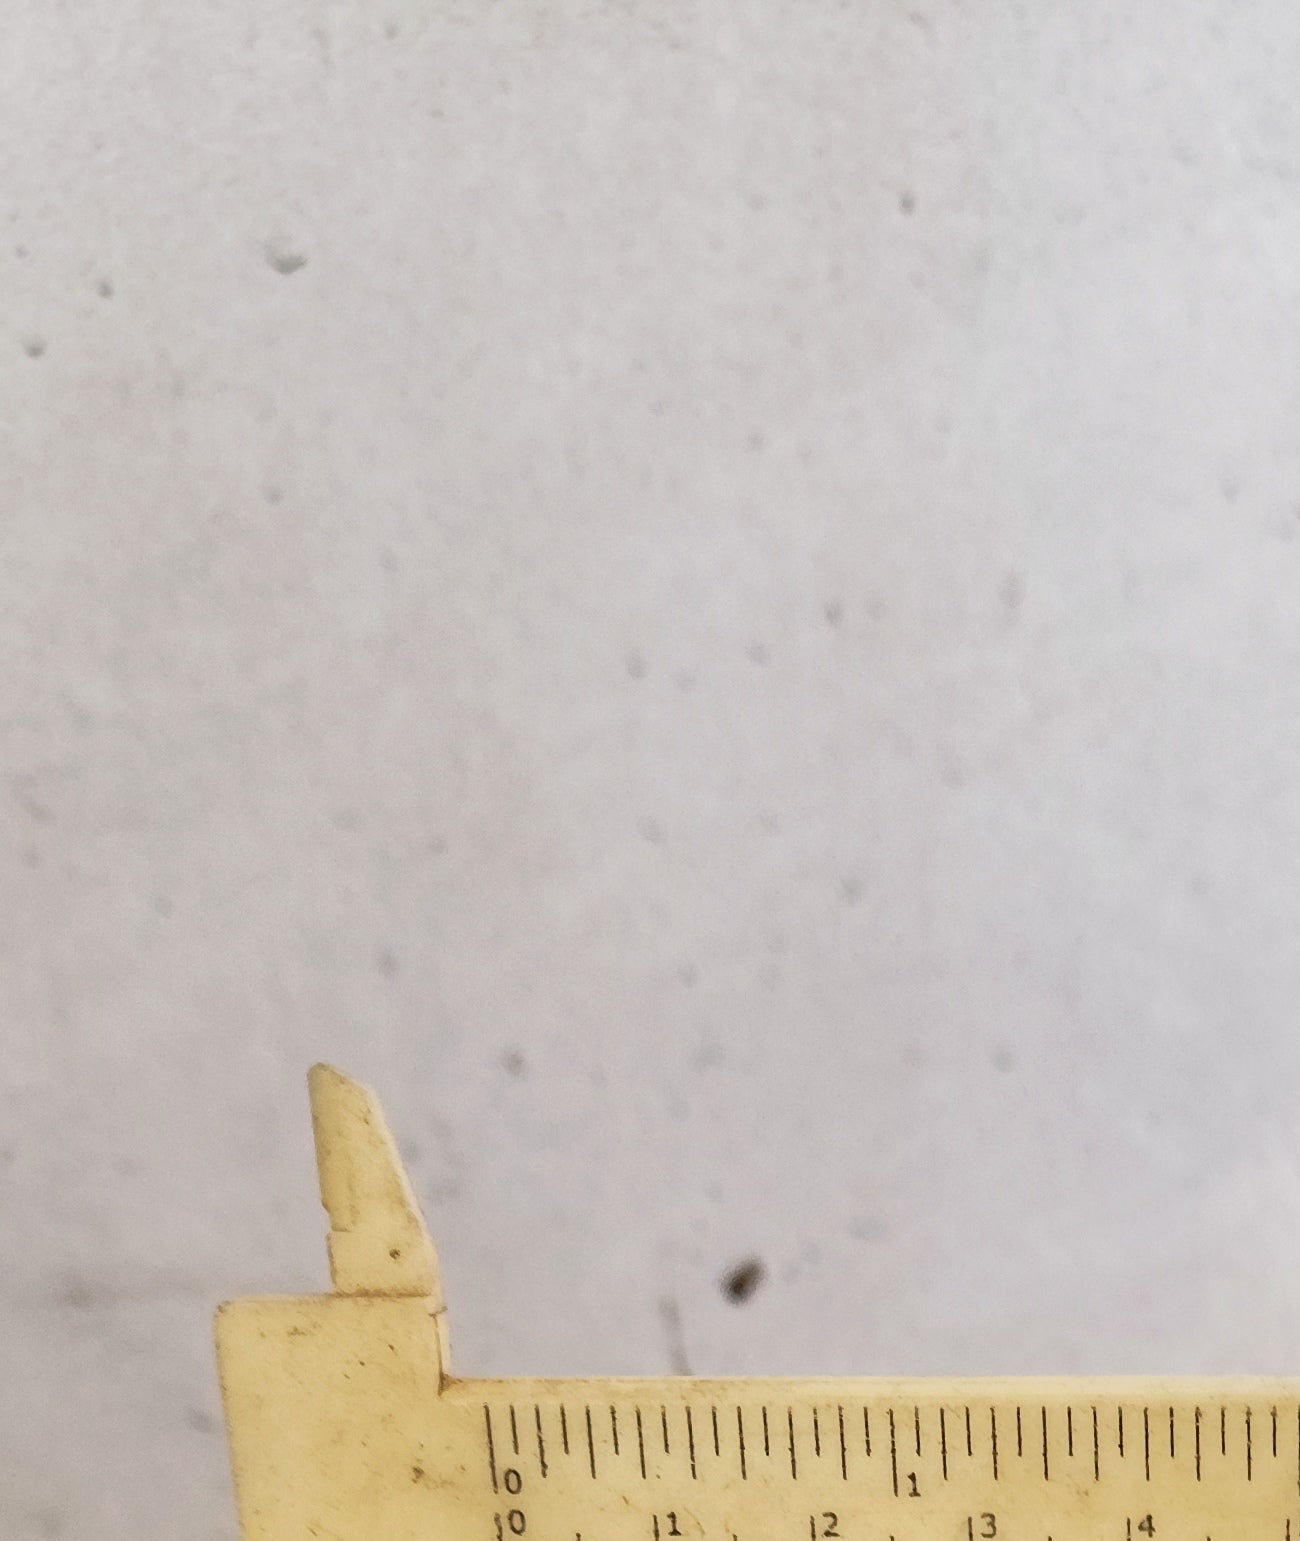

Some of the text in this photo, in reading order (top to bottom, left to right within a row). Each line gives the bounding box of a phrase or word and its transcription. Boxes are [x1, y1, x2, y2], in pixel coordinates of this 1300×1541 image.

[504, 1468, 522, 1495] 0
[907, 1472, 921, 1497] 1
[509, 1509, 527, 1536] 0
[667, 1512, 681, 1537] 1
[821, 1513, 841, 1537] 2
[980, 1513, 997, 1538] 3
[1137, 1513, 1156, 1539] 4
